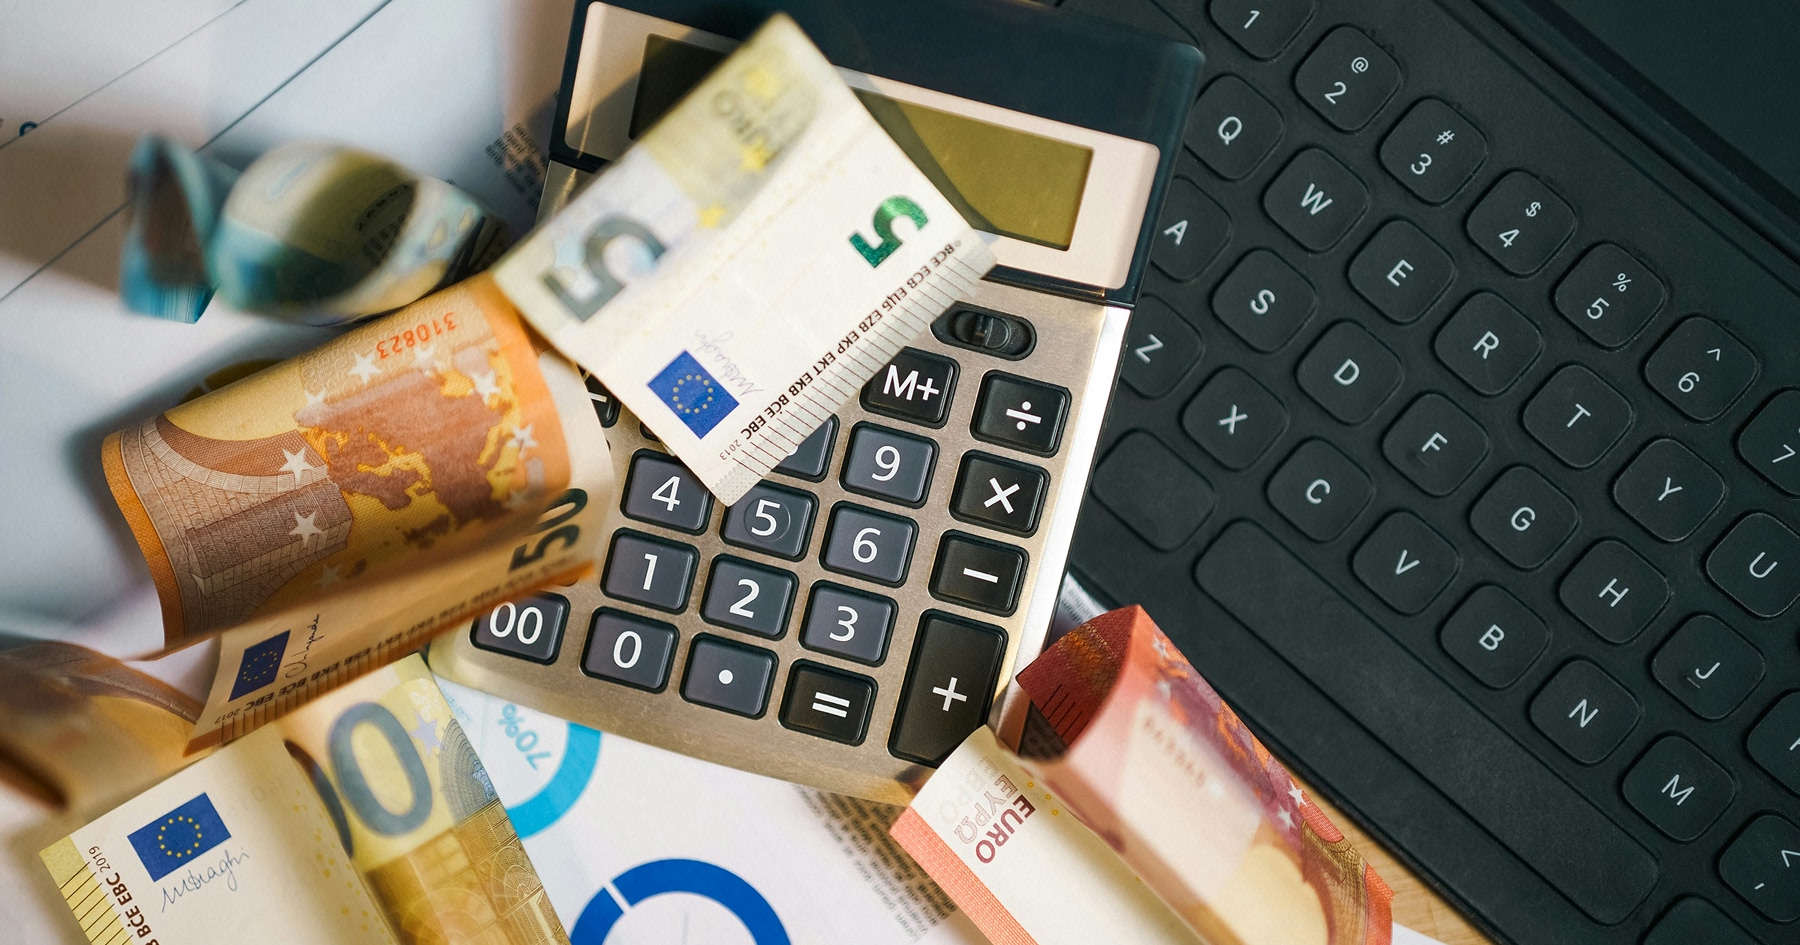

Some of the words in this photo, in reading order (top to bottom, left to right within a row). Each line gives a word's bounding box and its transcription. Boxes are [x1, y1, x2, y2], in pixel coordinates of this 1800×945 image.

[1243, 10, 1260, 29] 1
[1350, 56, 1369, 74] @
[1324, 81, 1347, 105] 2
[1218, 116, 1243, 146] Q
[1410, 153, 1433, 175] 3
[1300, 182, 1333, 216] W
[848, 195, 928, 268] 5
[1163, 219, 1189, 246] A
[1498, 228, 1520, 248] 4
[541, 214, 665, 321] 5
[1386, 259, 1414, 287] E
[1250, 289, 1276, 315] S
[1586, 297, 1610, 320] 5
[376, 311, 456, 359] 310823
[857, 309, 884, 334] EZB
[834, 329, 860, 355] EKP
[1134, 333, 1164, 363] Z
[1472, 330, 1500, 360] R
[810, 351, 837, 376] EKT
[1333, 358, 1360, 386] D
[787, 371, 814, 397] EKB
[883, 364, 940, 401] M+
[1677, 371, 1700, 393] 6
[740, 414, 767, 440] EBC
[1218, 404, 1248, 435] X
[1566, 403, 1592, 428] T
[720, 440, 742, 462] 2013
[1421, 431, 1448, 453] F
[1772, 444, 1796, 463] 7
[871, 445, 901, 482] 9
[651, 475, 681, 512] 4
[1305, 478, 1331, 505] C
[1657, 476, 1683, 502] Y
[751, 499, 781, 536] 5
[1510, 506, 1536, 532] G
[852, 527, 881, 563] 6
[643, 553, 658, 591] 1
[1395, 549, 1420, 575] V
[1749, 551, 1778, 579] U
[729, 578, 760, 619] 2
[1598, 577, 1630, 608] H
[489, 602, 543, 645] 00
[829, 605, 859, 642] 3
[1478, 624, 1505, 651] B
[613, 630, 642, 669] 0
[1695, 661, 1721, 680] J
[215, 707, 240, 725] 2017
[245, 691, 274, 713] EBC
[1568, 698, 1599, 728] N
[497, 704, 552, 772] 70%
[1661, 774, 1695, 806] M
[975, 794, 1036, 864] EURO
[88, 845, 111, 873] 2019
[106, 872, 133, 905] EBC
